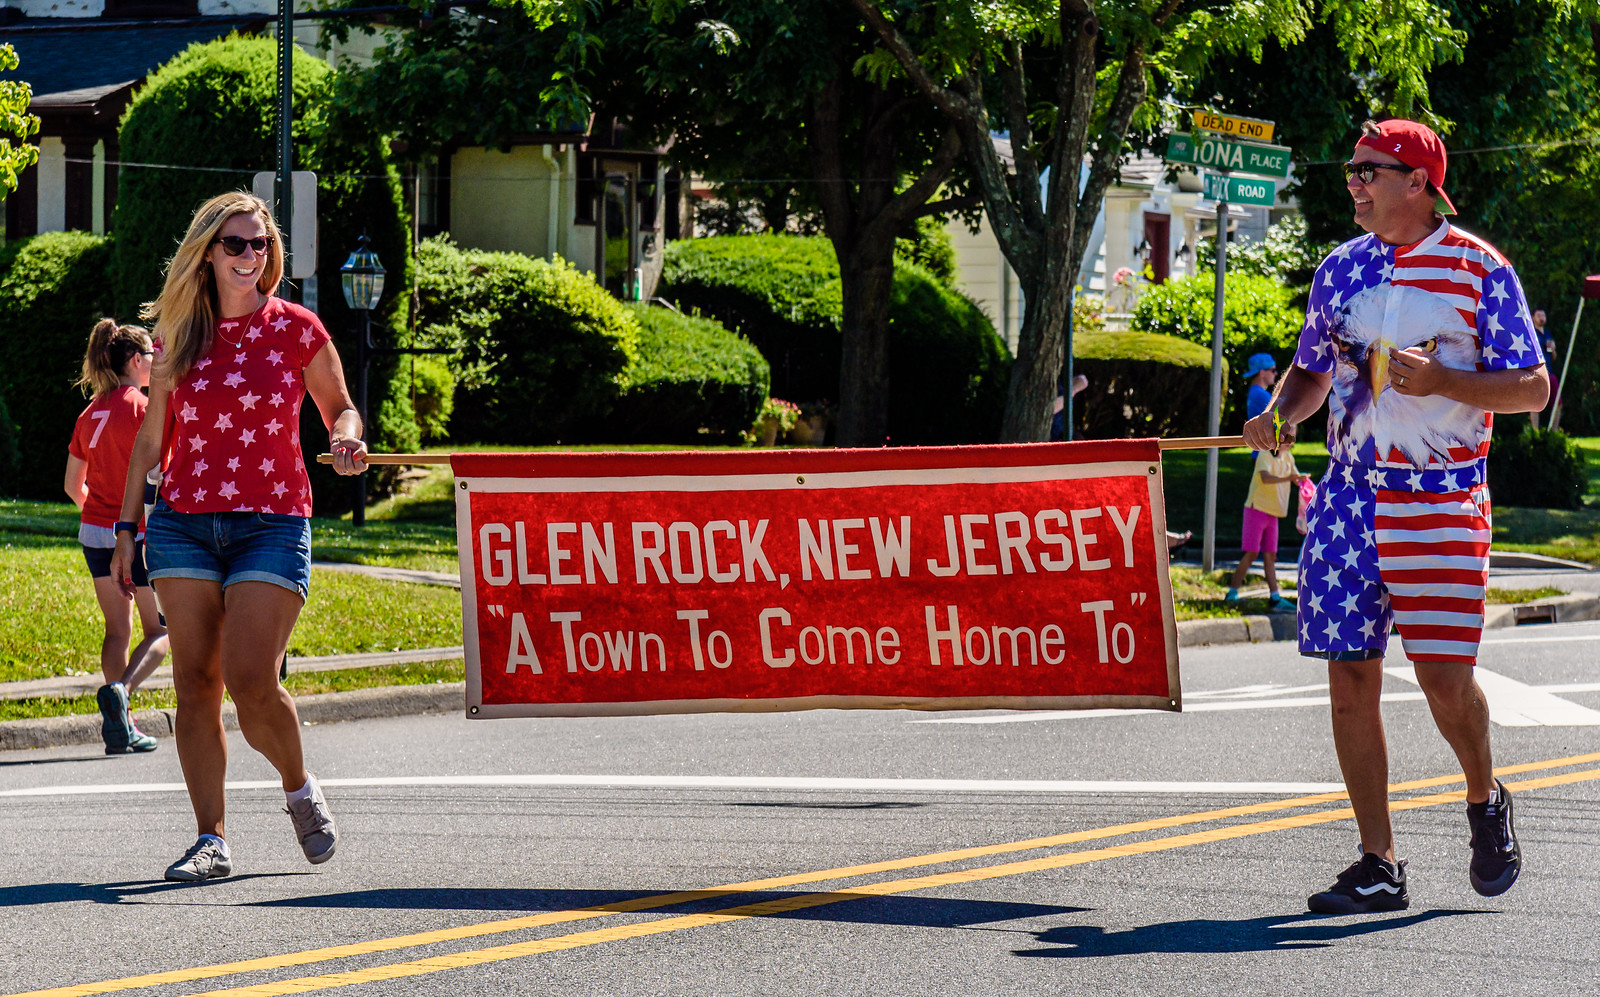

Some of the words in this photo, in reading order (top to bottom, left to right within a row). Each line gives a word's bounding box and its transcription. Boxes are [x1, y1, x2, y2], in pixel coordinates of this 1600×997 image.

[1239, 122, 1263, 137] END
[1193, 140, 1244, 169] IONA
[1250, 153, 1283, 170] PLACE
[1393, 143, 1402, 152] 2
[1238, 184, 1266, 199] ROAD
[89, 410, 111, 449] 7
[479, 521, 619, 586] GLEN
[631, 519, 791, 591] ROCK,
[798, 515, 911, 581] NEW
[926, 505, 1142, 577] JERSEY
[549, 611, 667, 673] Town
[676, 609, 733, 671] To
[758, 607, 901, 669] Come
[924, 604, 1066, 667] Home
